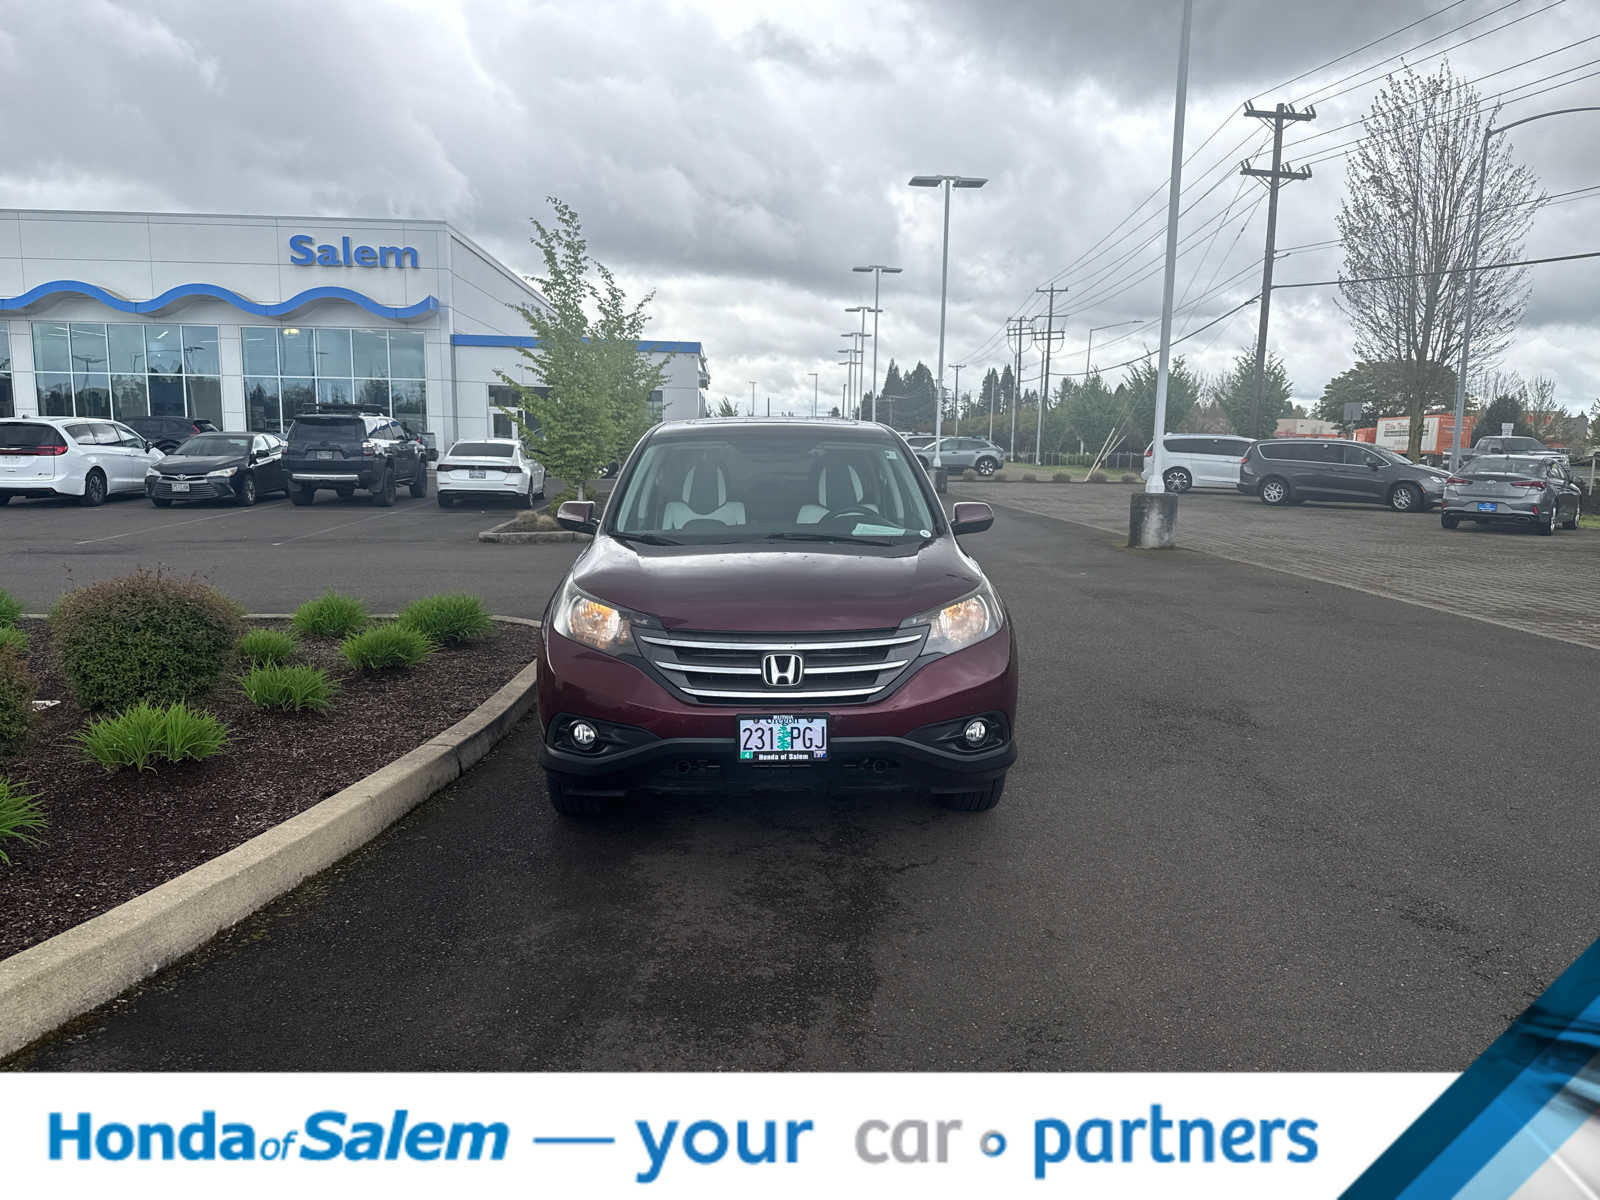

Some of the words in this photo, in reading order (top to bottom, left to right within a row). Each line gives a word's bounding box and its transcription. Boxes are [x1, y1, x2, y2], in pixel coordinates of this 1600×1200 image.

[289, 234, 419, 268] Salem
[742, 727, 774, 750] 231
[790, 726, 825, 750] PGJ
[758, 753, 779, 761] Honda
[780, 753, 787, 761] of
[788, 753, 809, 761] Salem
